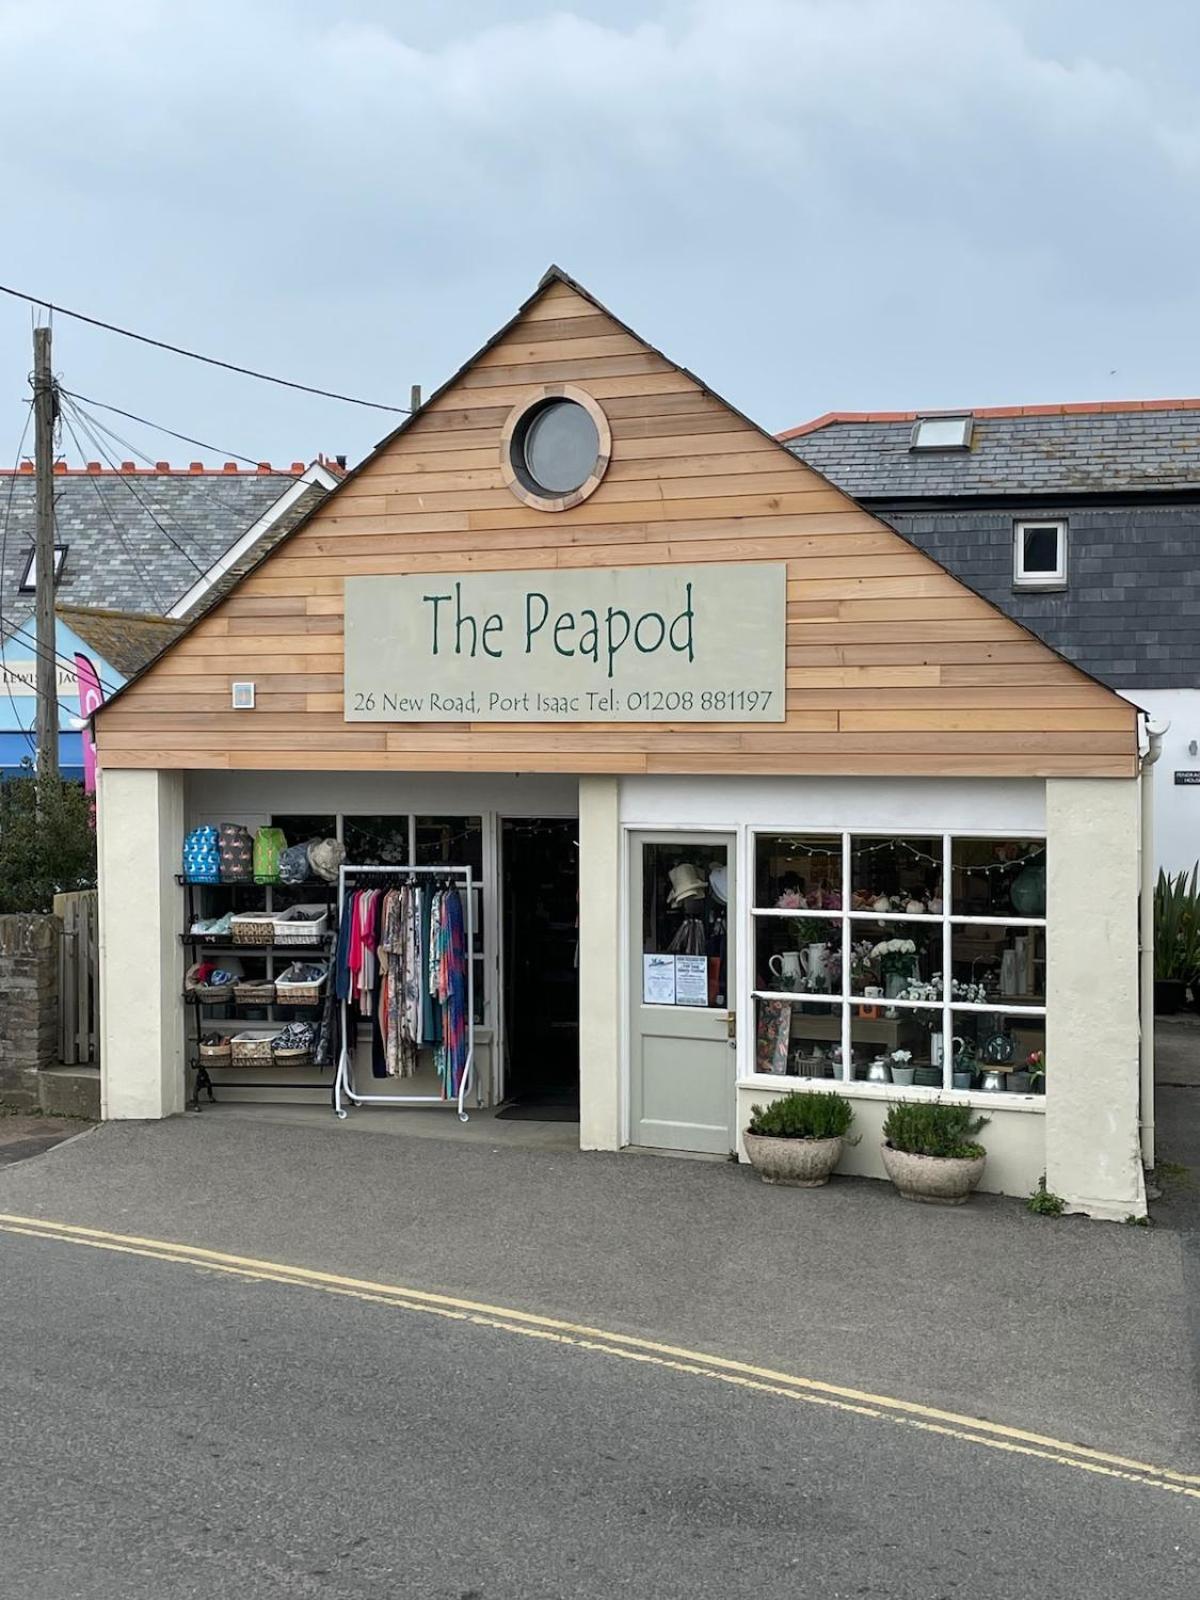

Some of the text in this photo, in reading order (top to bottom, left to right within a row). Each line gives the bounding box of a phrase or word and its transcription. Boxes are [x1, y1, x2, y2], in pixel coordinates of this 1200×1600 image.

[422, 582, 695, 678] The Peapod
[3, 672, 39, 684] LEWI
[353, 686, 774, 715] 26 New Road, Port Isaac Tel: 01208 881197
